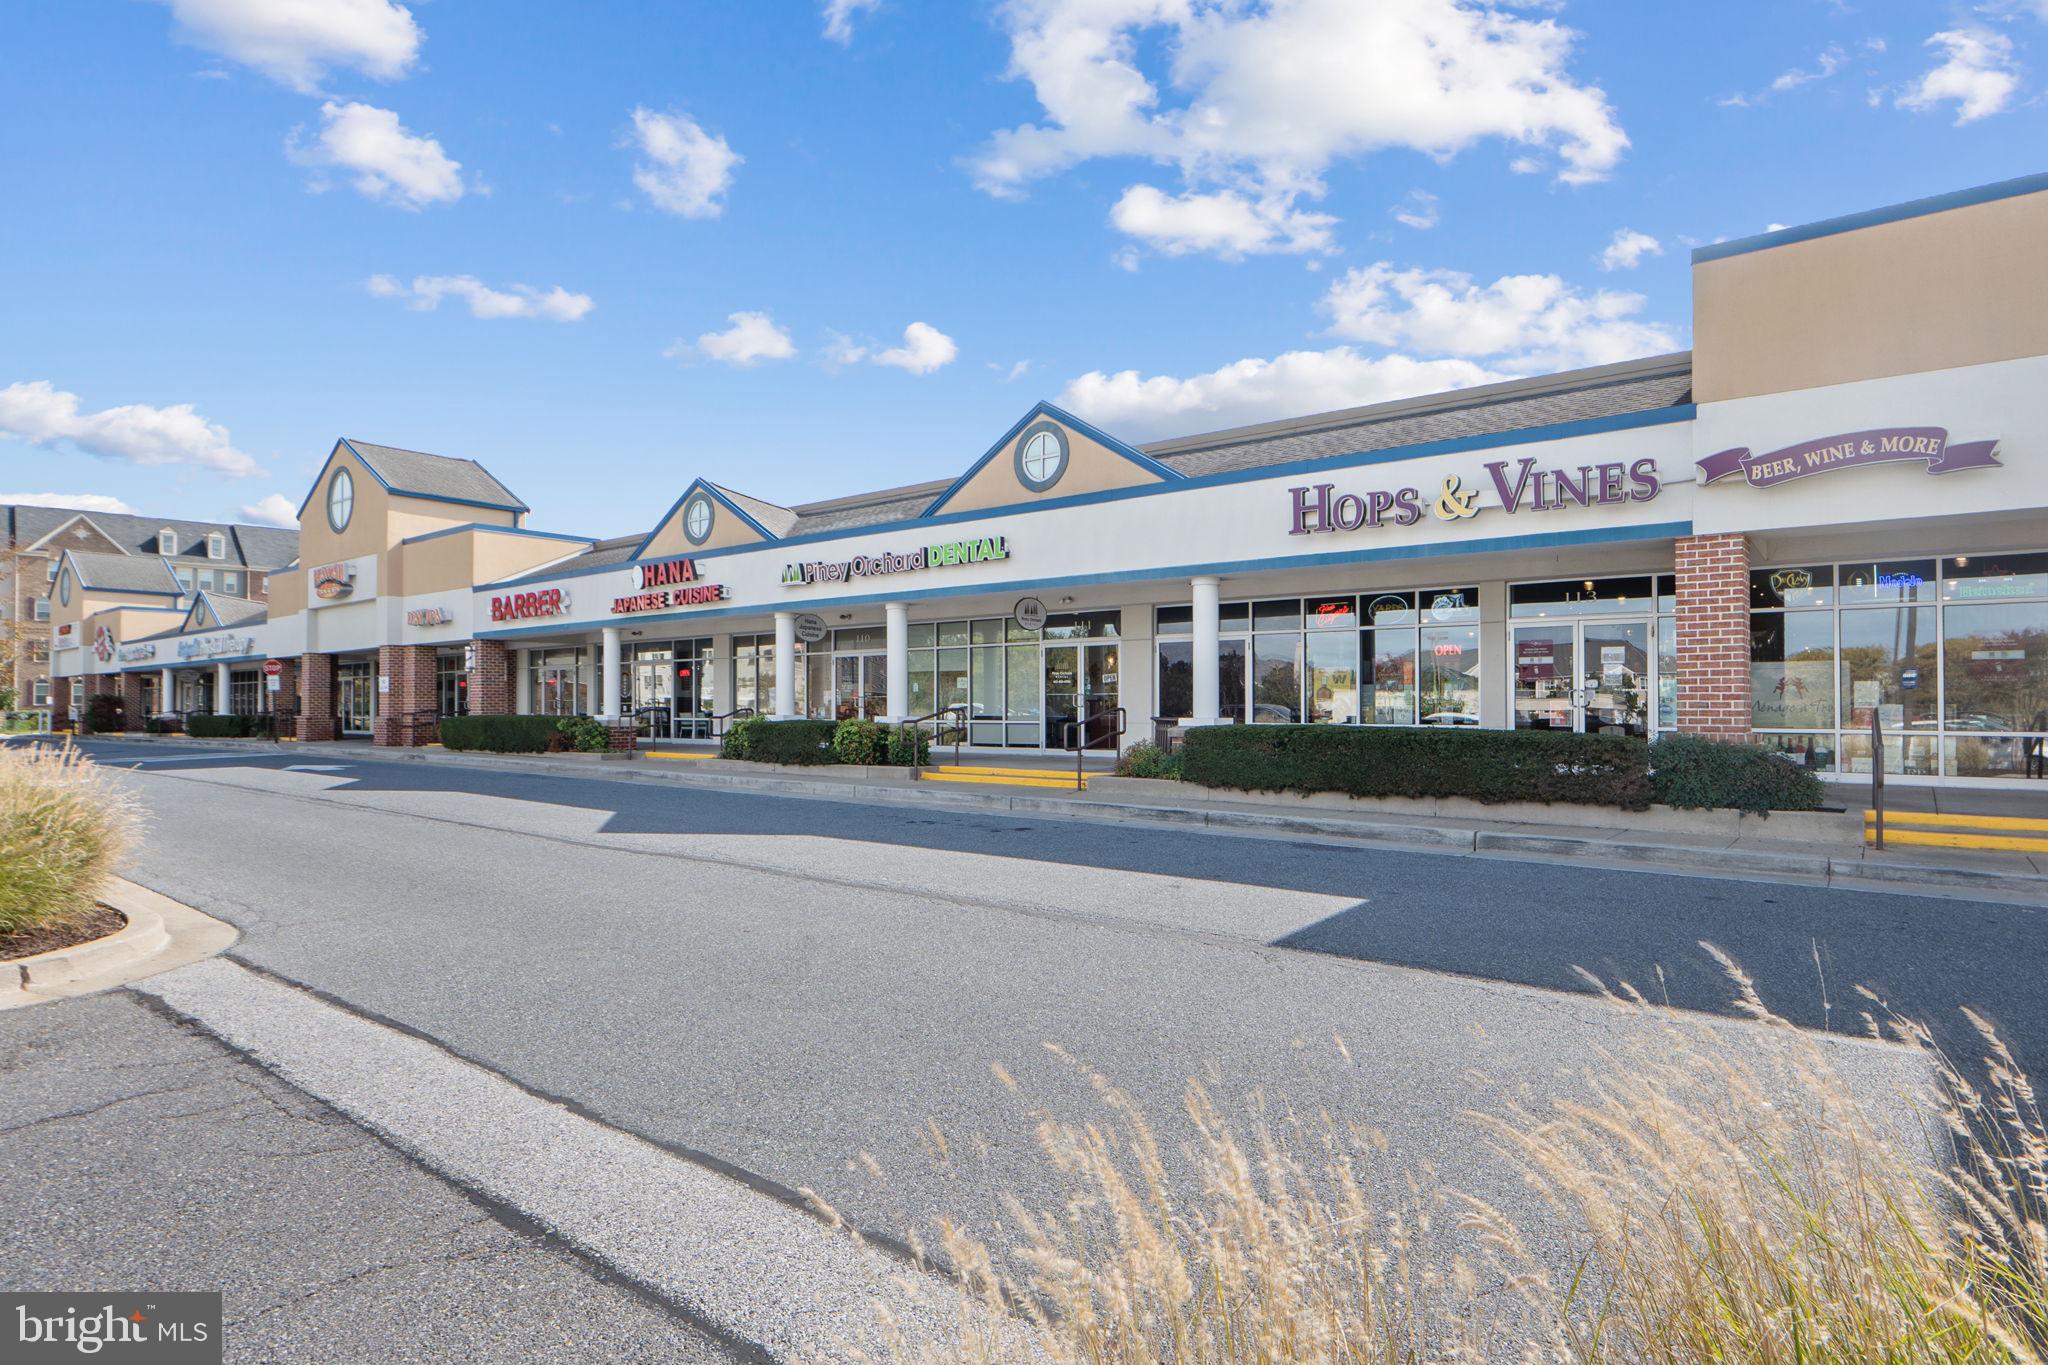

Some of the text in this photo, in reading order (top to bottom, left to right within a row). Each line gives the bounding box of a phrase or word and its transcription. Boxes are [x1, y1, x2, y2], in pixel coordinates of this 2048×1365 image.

[1751, 435, 1941, 480] BEER, WINE & MORE
[1434, 473, 1479, 521] &
[643, 558, 695, 587] HANA
[805, 536, 1006, 583] Piney Orchard DENTAL
[491, 588, 562, 621] BARBER
[610, 584, 721, 614] JAPANESE CUISINE
[1565, 591, 1597, 604] 113
[856, 634, 871, 643] 110
[1434, 644, 1462, 657] OPEN
[263, 664, 282, 672] STOP
[1103, 674, 1117, 682] OPEN
